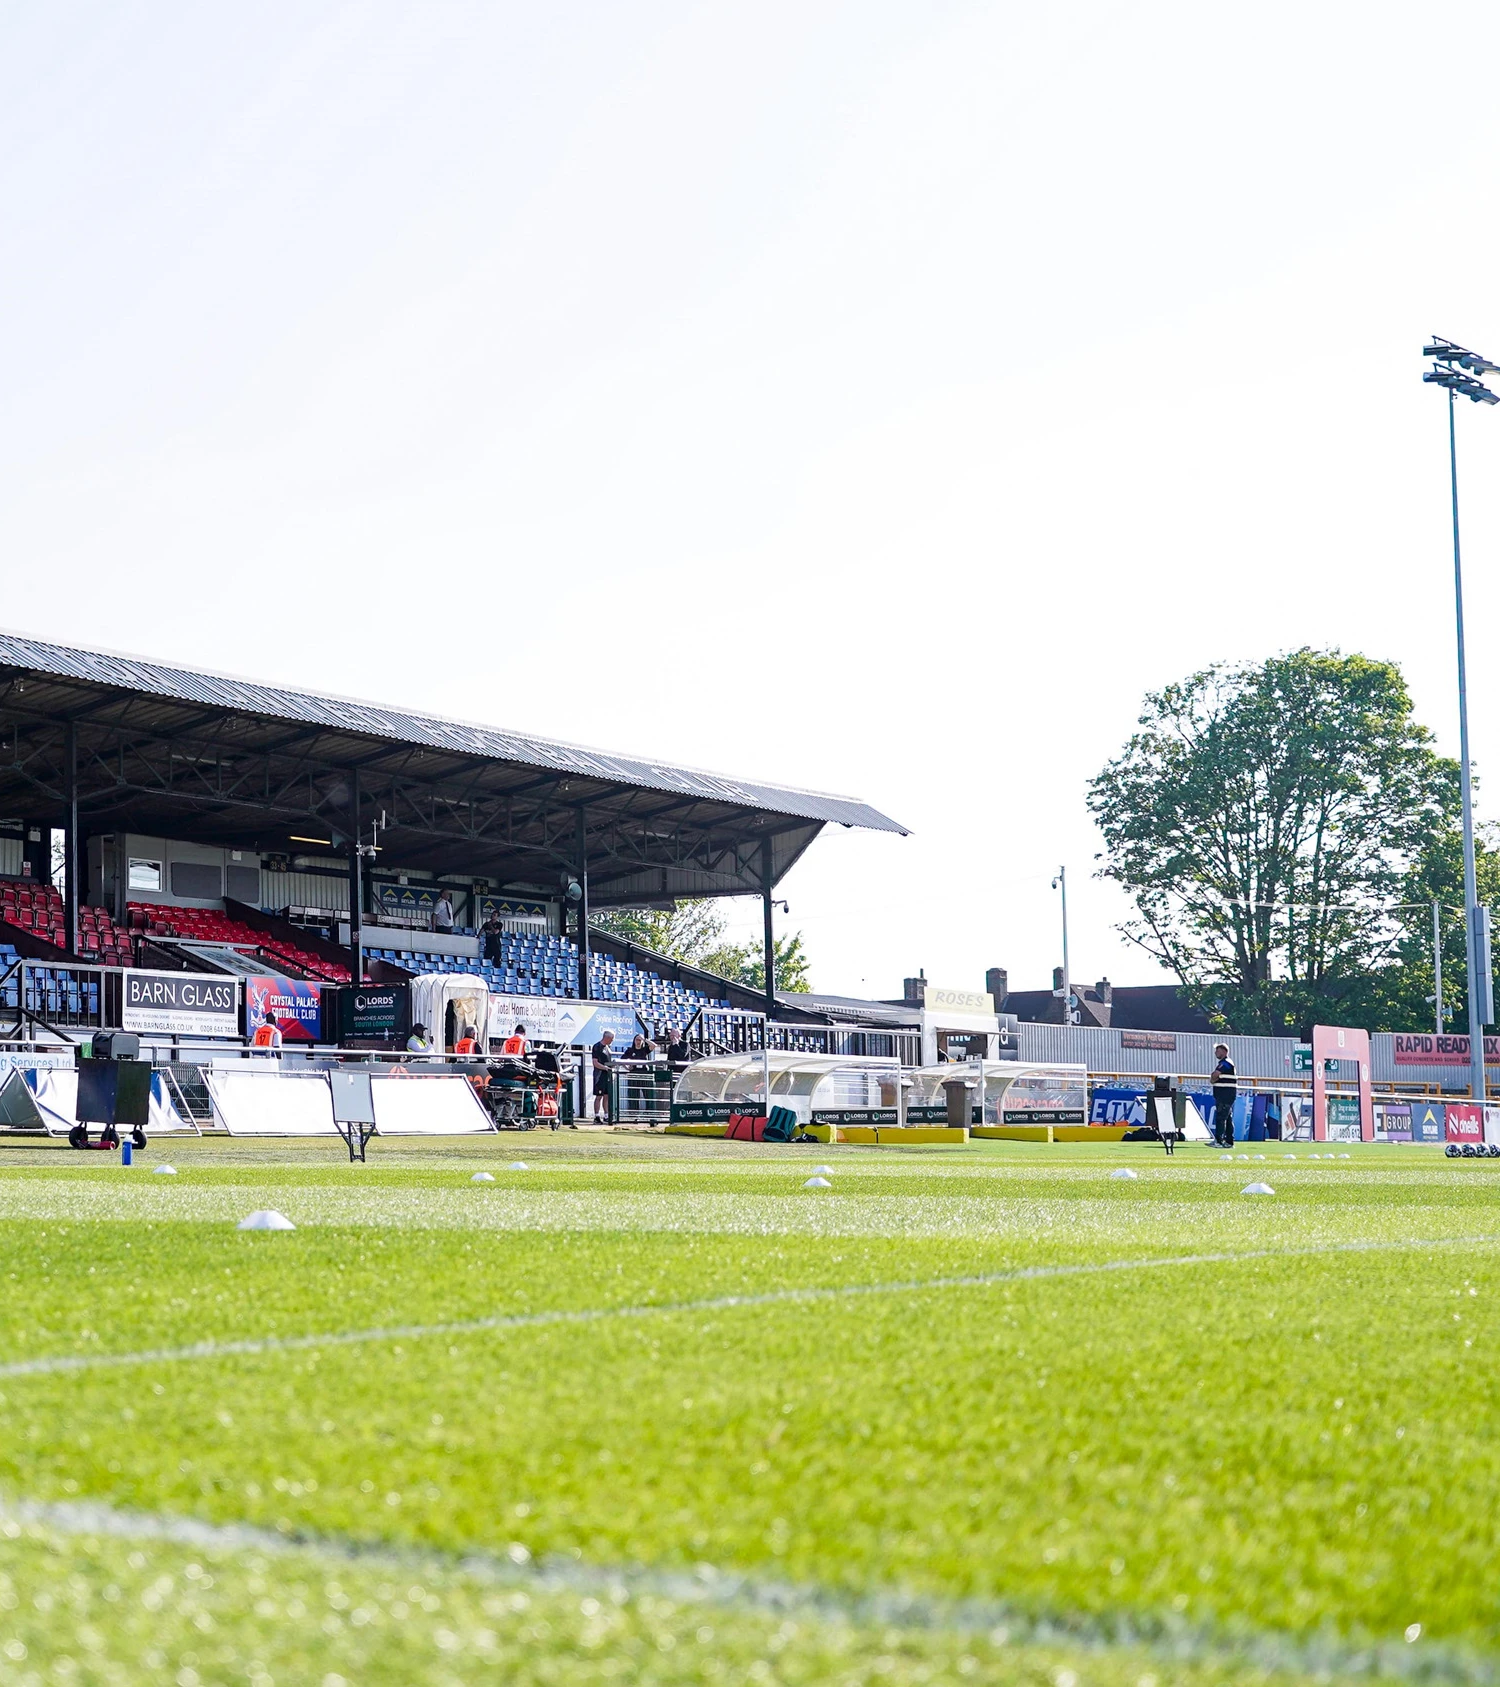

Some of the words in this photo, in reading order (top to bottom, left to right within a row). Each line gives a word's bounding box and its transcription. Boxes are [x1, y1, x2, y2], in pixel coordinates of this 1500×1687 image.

[131, 980, 176, 1004] BARN
[181, 984, 231, 1008] GLASS
[367, 996, 394, 1005] LORDS
[935, 991, 984, 1007] ROSES
[270, 995, 295, 1006] CRYSTAL
[296, 996, 318, 1008] PALACE
[272, 1008, 300, 1020] FOOTBALL
[301, 1009, 316, 1020] CLUB
[497, 1002, 510, 1015] Total
[511, 1003, 529, 1016] Home
[1396, 1036, 1432, 1053] RAPID
[1483, 1038, 1499, 1054] IX
[10, 1056, 54, 1068] Services
[1386, 1116, 1412, 1131] GROUP
